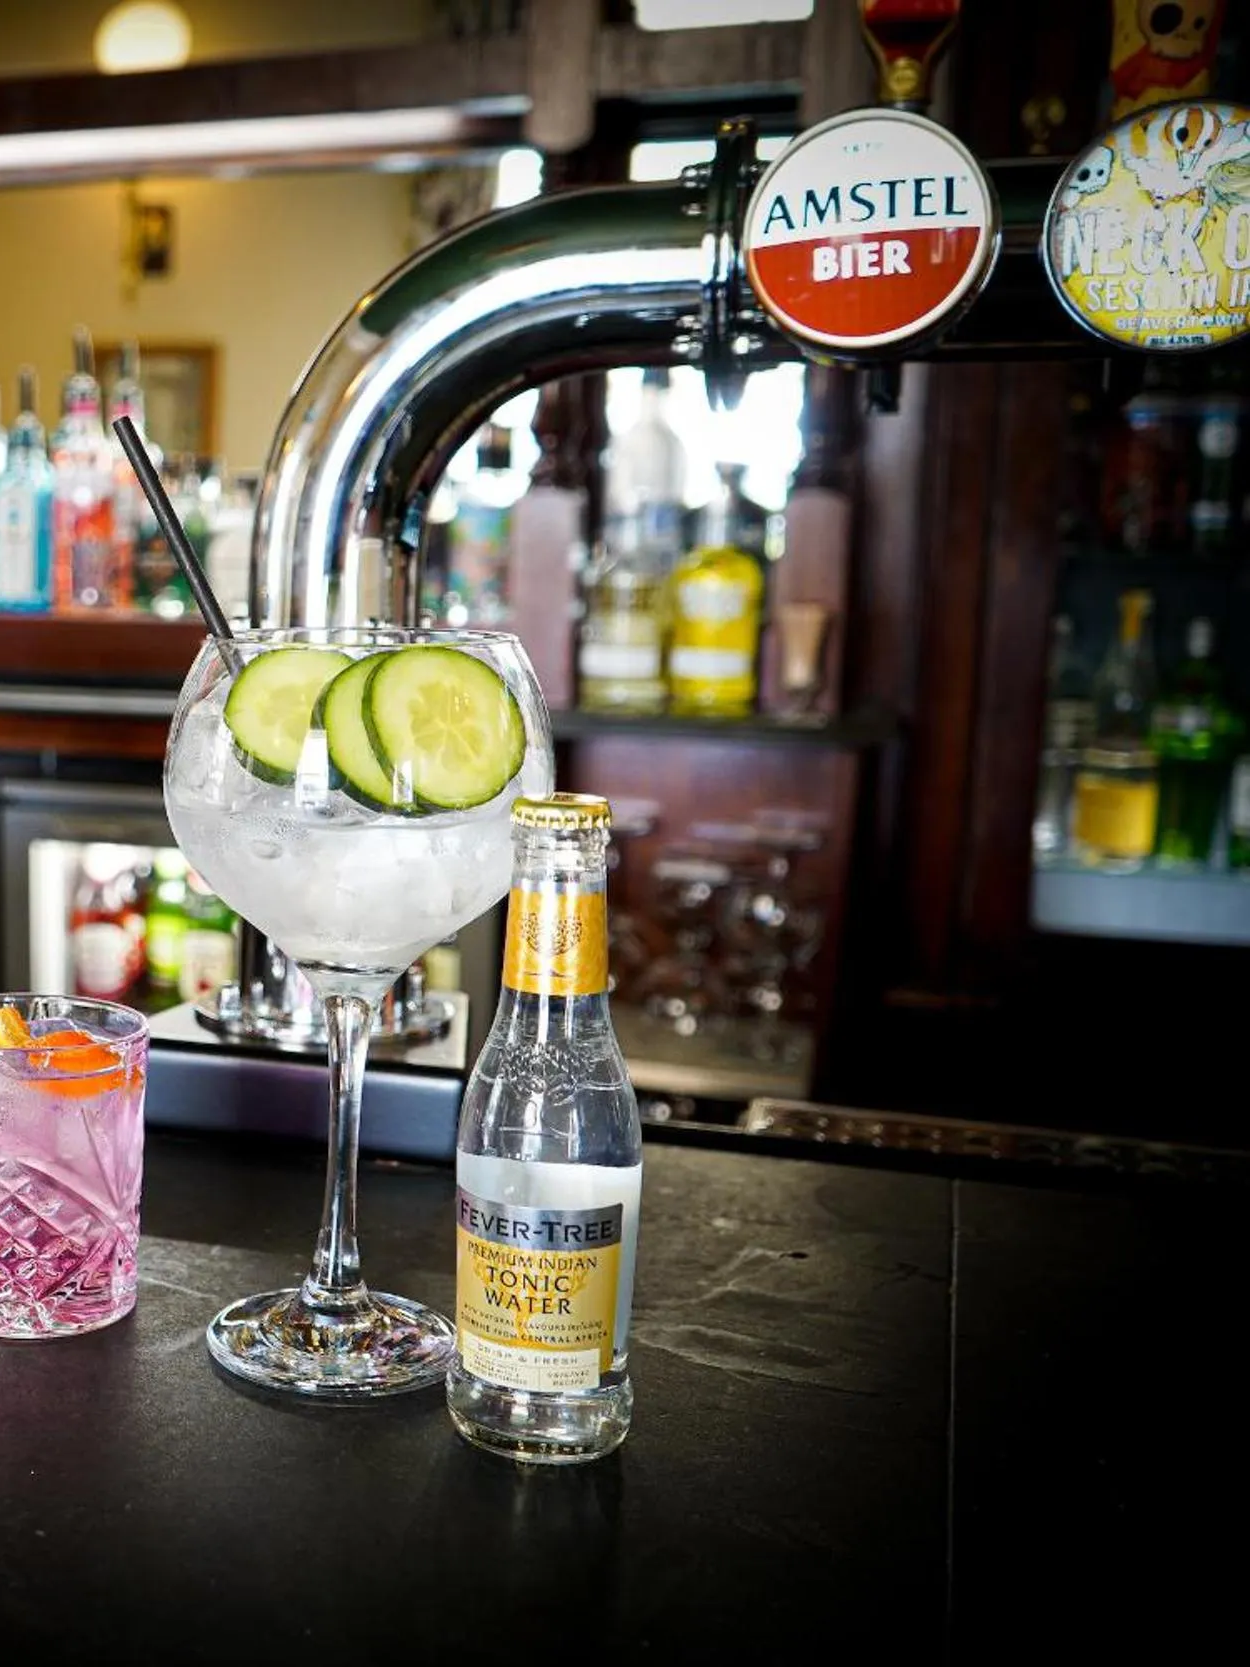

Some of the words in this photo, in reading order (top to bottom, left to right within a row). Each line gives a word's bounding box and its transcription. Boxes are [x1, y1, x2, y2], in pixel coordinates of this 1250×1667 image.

[763, 175, 968, 234] AMSTEL
[1061, 203, 1210, 277] NECK
[812, 239, 912, 283] BIER
[1087, 273, 1219, 312] SESON
[460, 1198, 614, 1243] FEVER-TREE
[467, 1240, 533, 1269] PREMIUM
[538, 1256, 598, 1271] INDIAN
[486, 1265, 571, 1293] TONIC
[484, 1287, 572, 1315] WATER
[520, 1332, 570, 1344] CENTRAL
